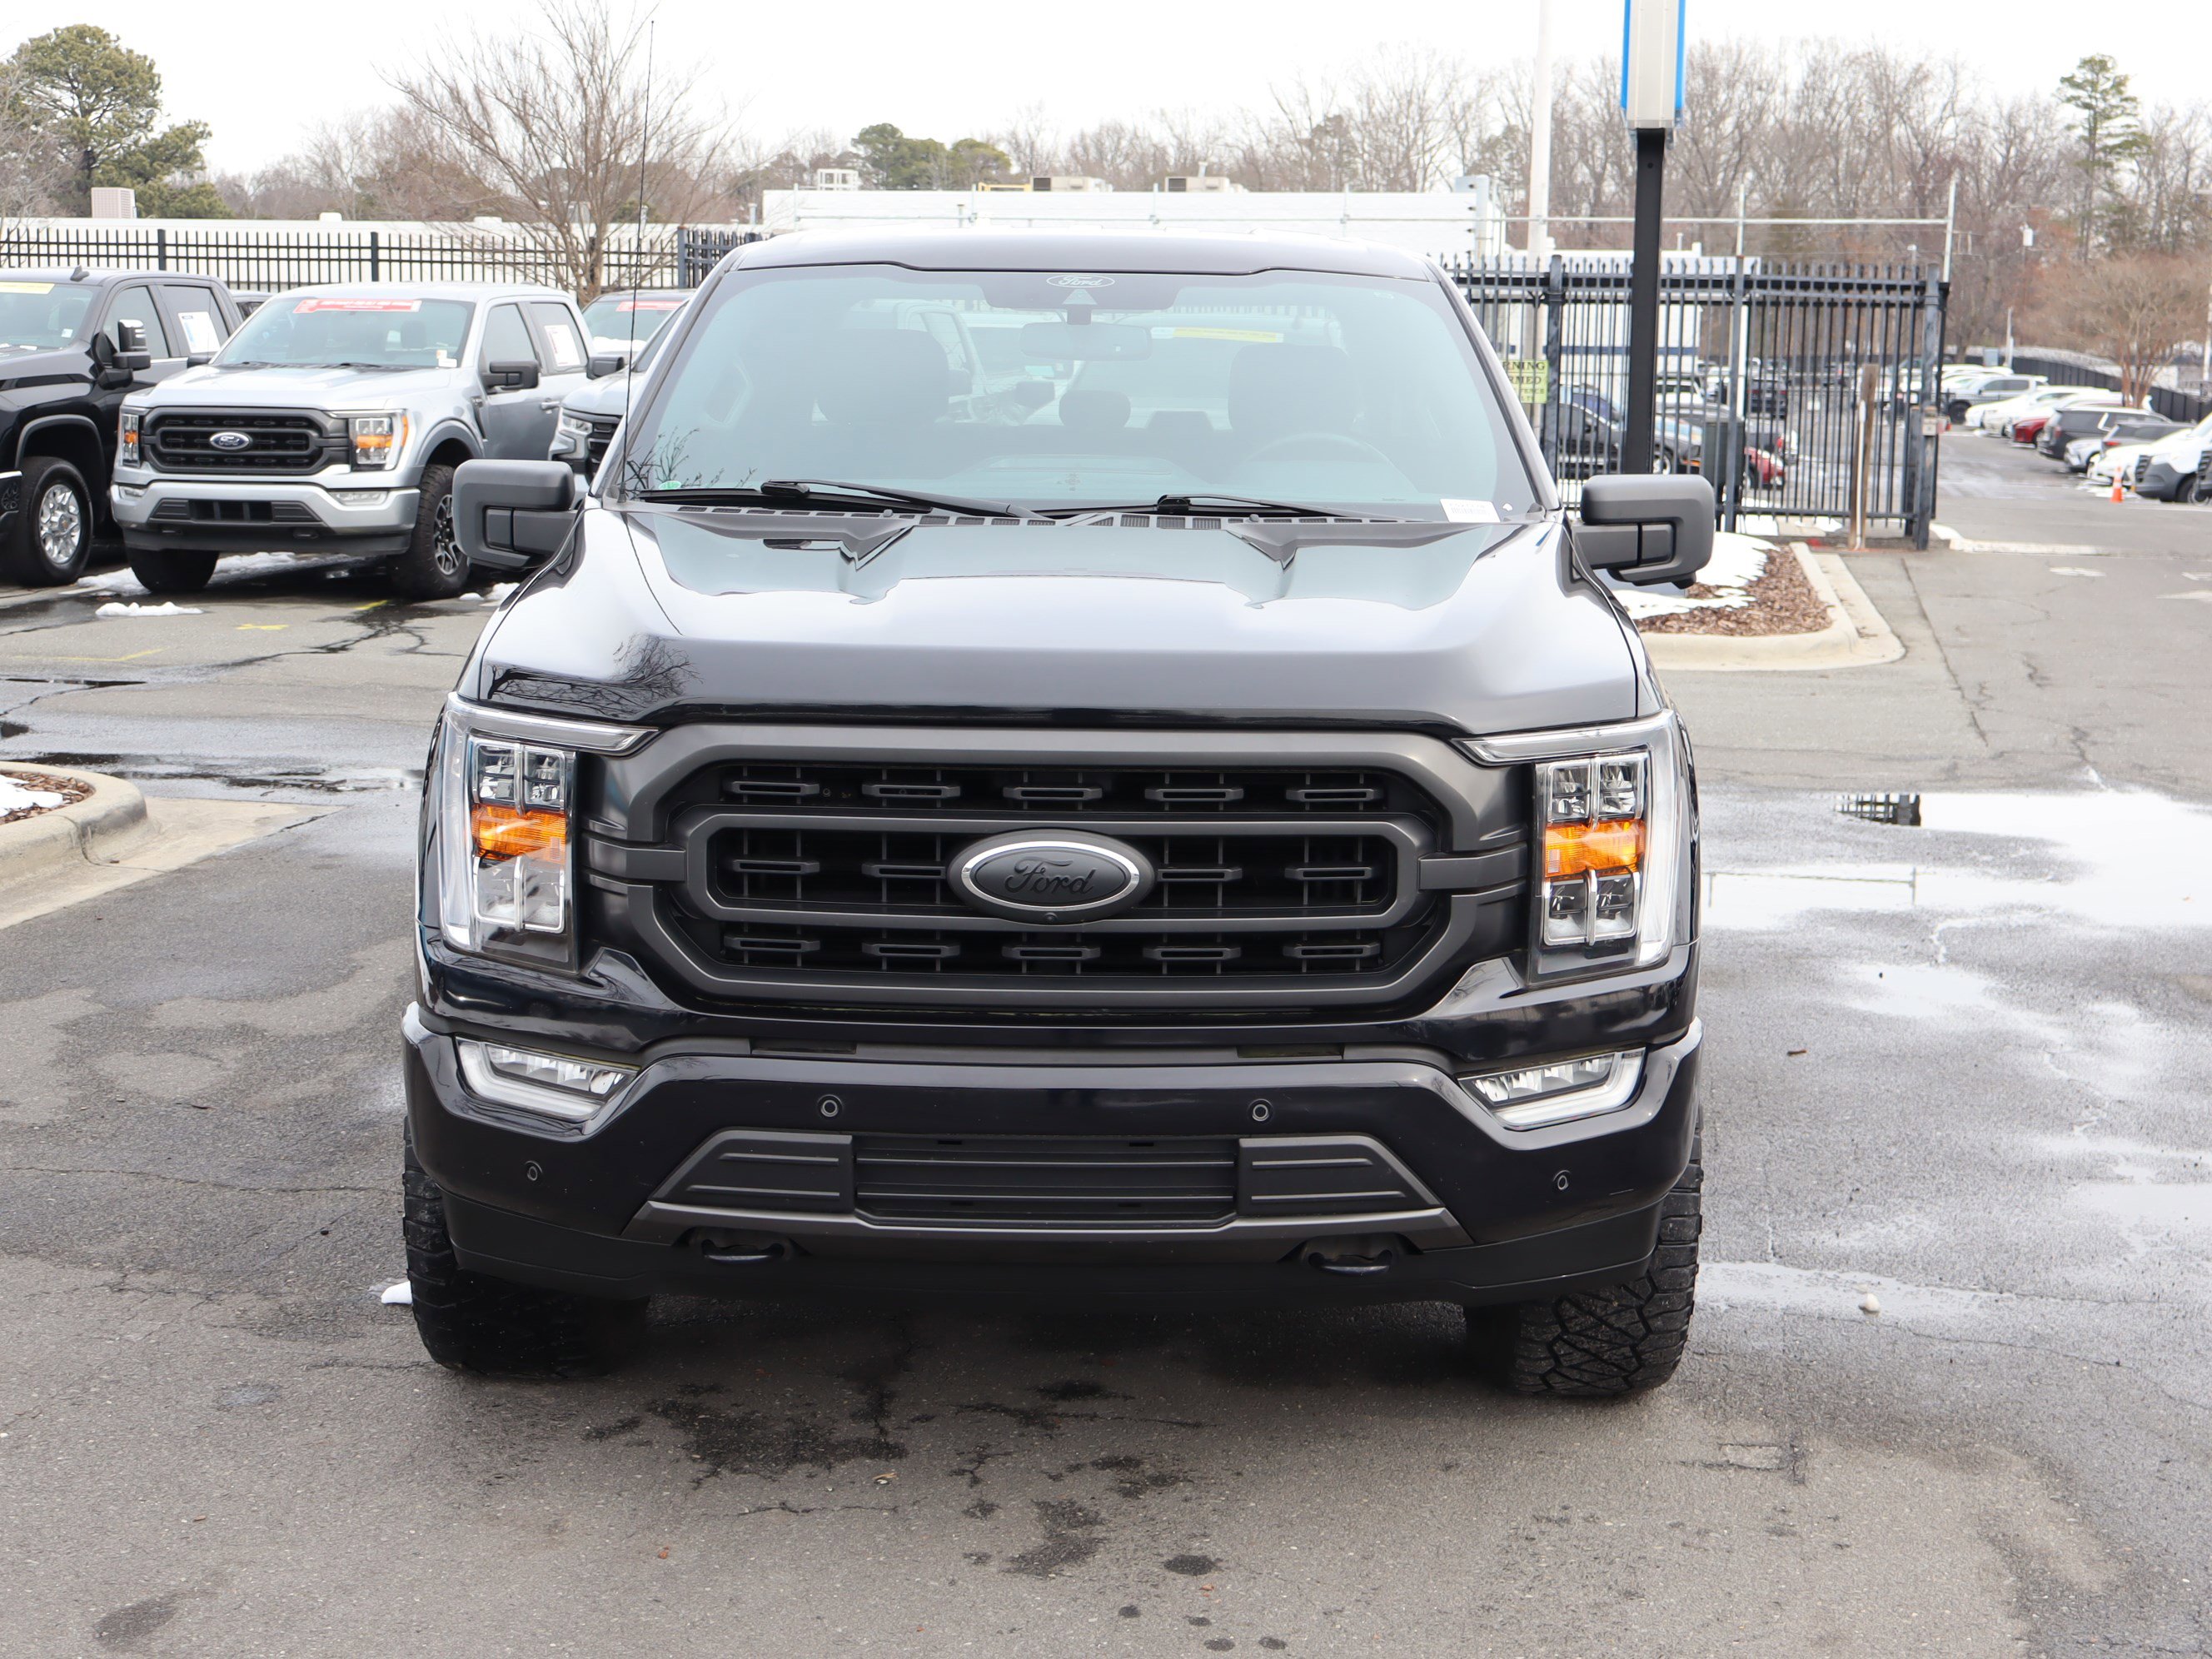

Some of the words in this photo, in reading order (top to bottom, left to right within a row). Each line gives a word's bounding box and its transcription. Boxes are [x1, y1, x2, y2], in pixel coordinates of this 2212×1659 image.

[1058, 276, 1104, 286] Ford
[1502, 361, 1546, 371] RNING
[1508, 376, 1542, 385] RMED
[1004, 856, 1098, 894] Ford
